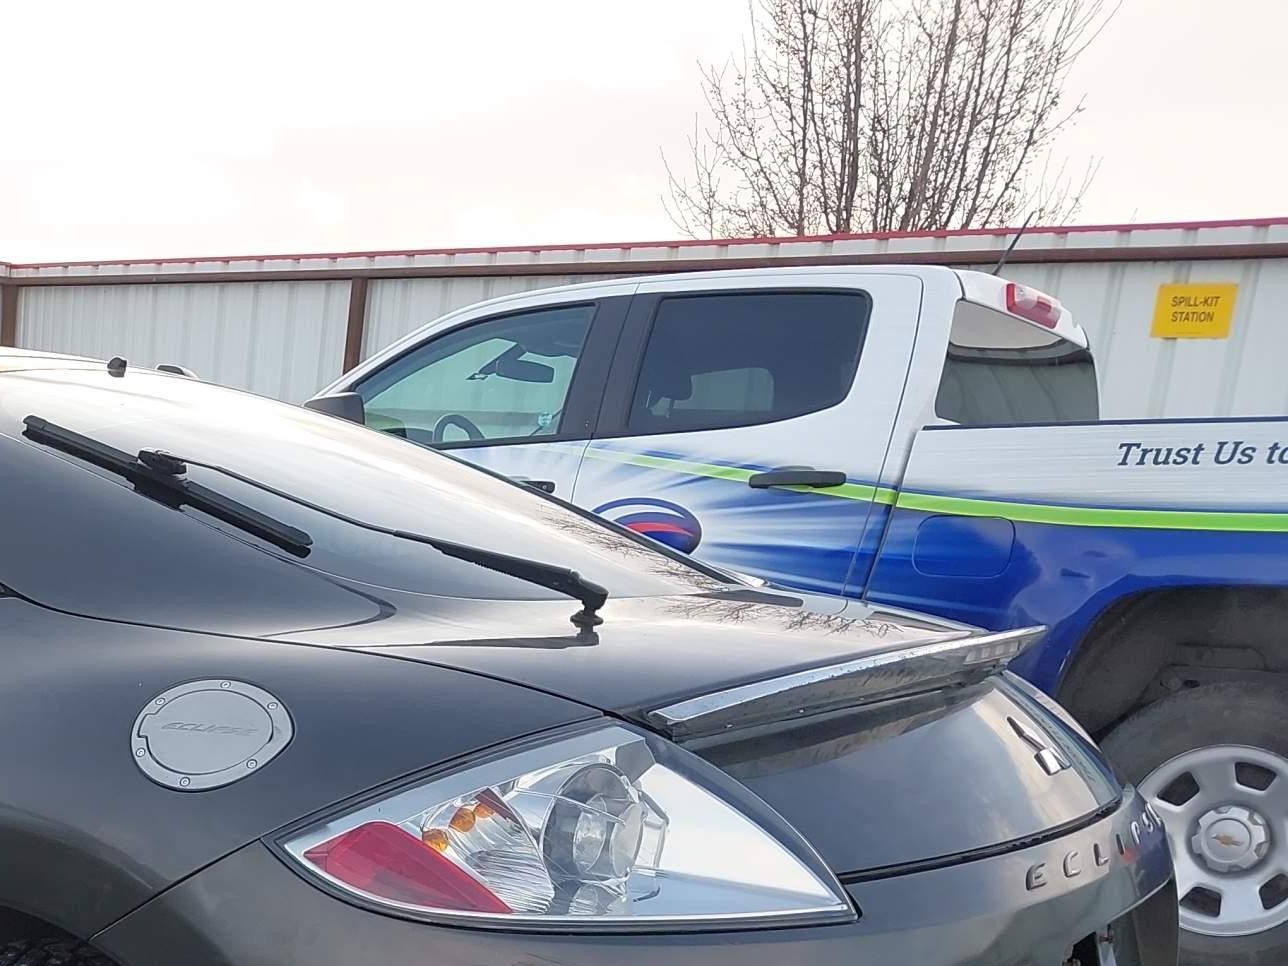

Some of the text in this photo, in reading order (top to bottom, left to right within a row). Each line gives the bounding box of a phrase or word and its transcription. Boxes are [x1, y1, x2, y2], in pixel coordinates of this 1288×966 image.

[1171, 295, 1221, 307] SPILL-KIT
[1171, 311, 1215, 323] STATION
[1117, 442, 1205, 466] Trust
[1214, 441, 1257, 465] Us
